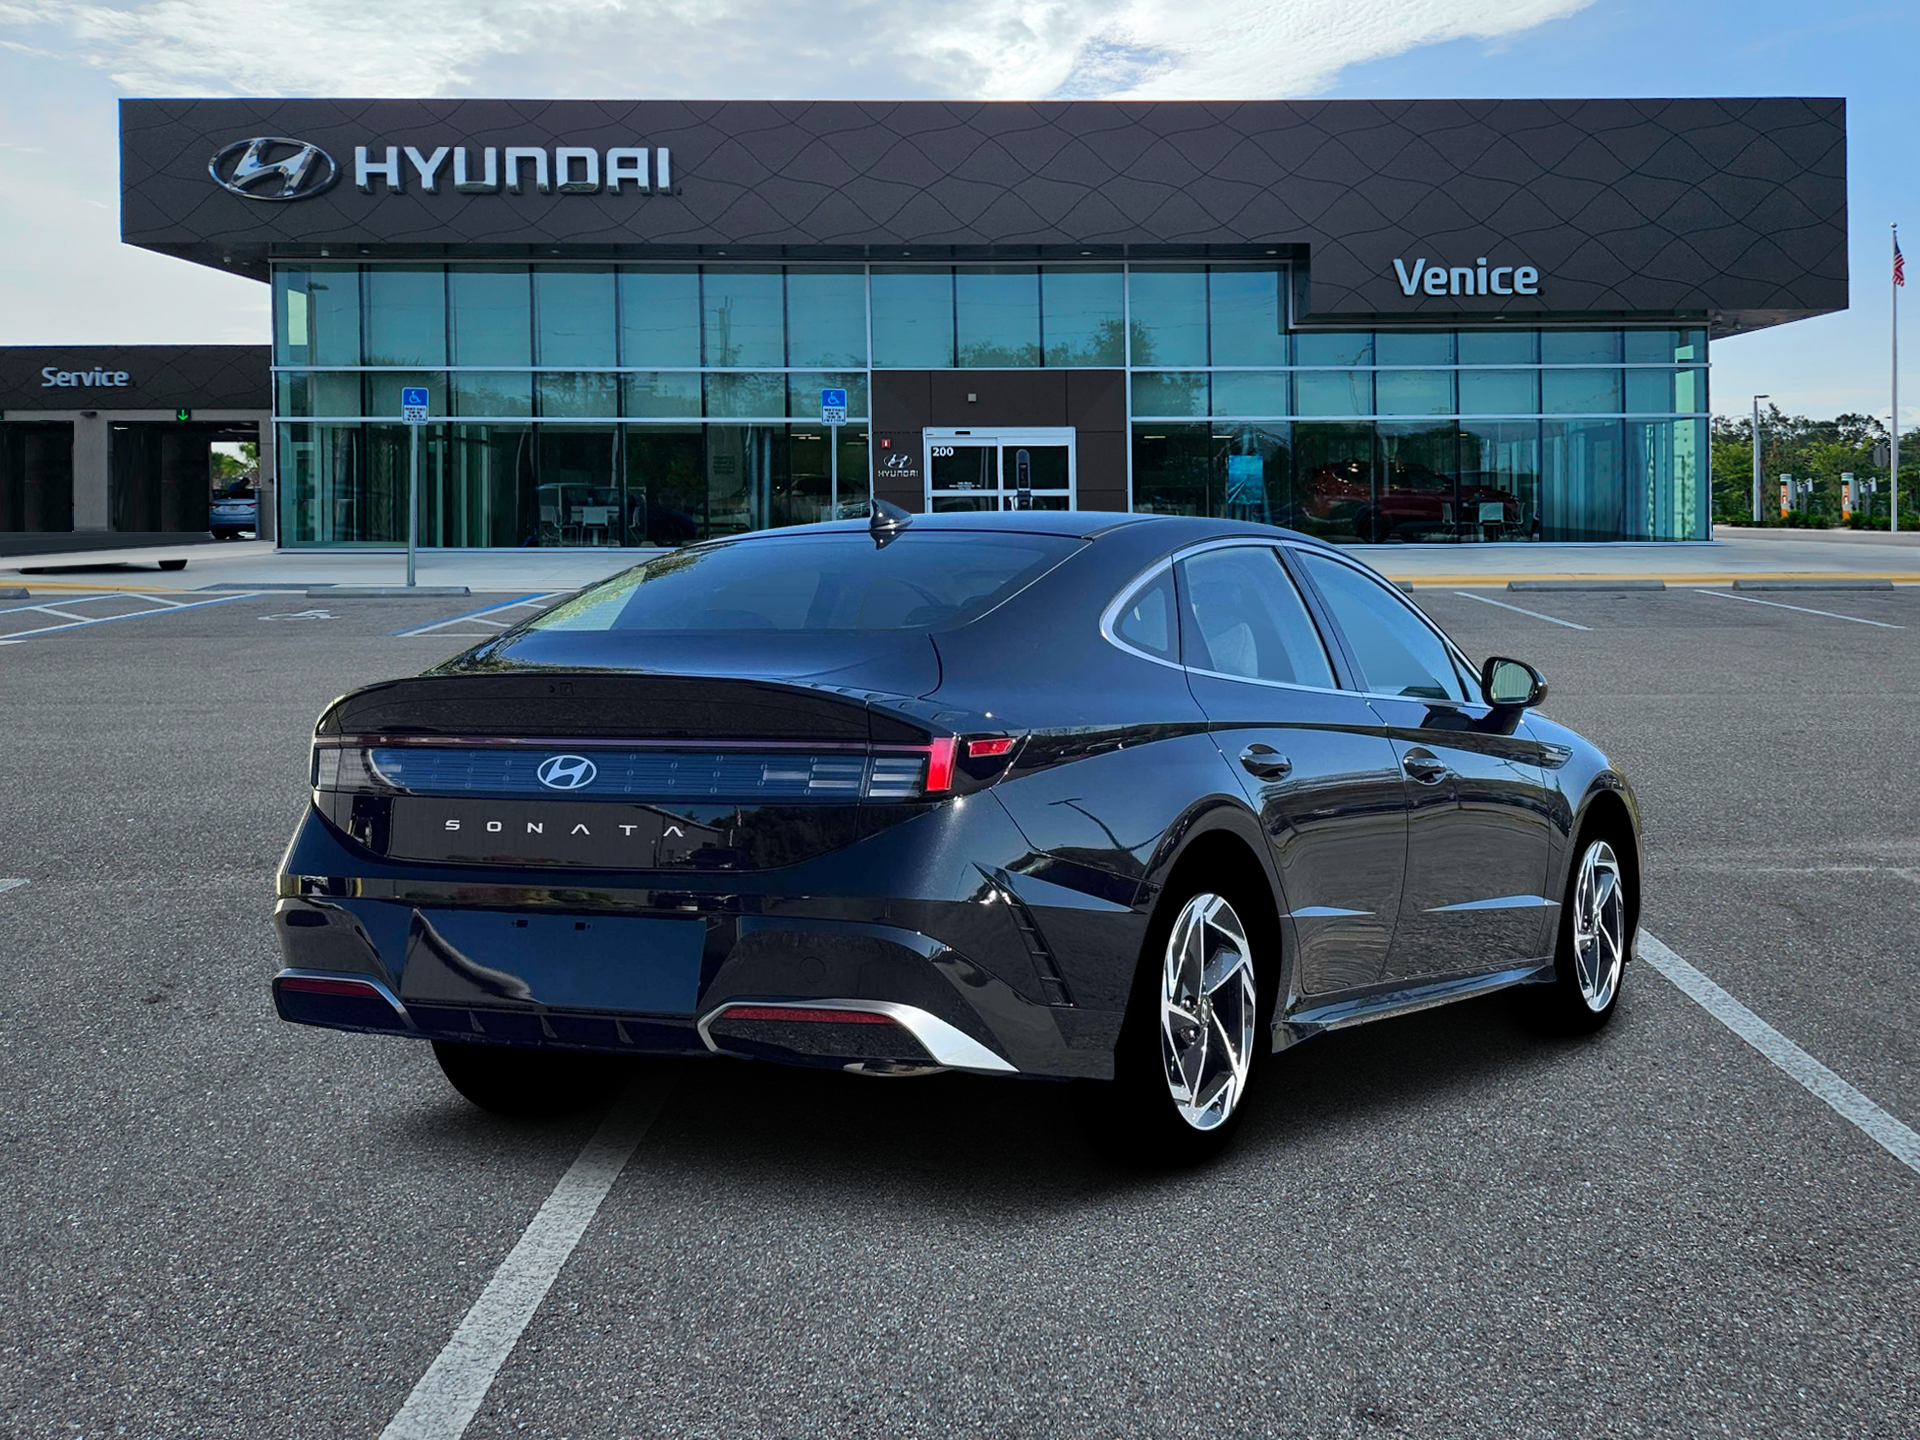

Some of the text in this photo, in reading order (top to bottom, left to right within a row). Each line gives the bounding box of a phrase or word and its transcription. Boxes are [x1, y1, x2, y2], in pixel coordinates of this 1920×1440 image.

[355, 146, 671, 193] HYUNDAI
[1392, 256, 1540, 296] Venice
[41, 366, 130, 387] Service
[932, 446, 954, 457] 200
[877, 469, 919, 478] HYUNDAI
[445, 819, 684, 838] SONATA
